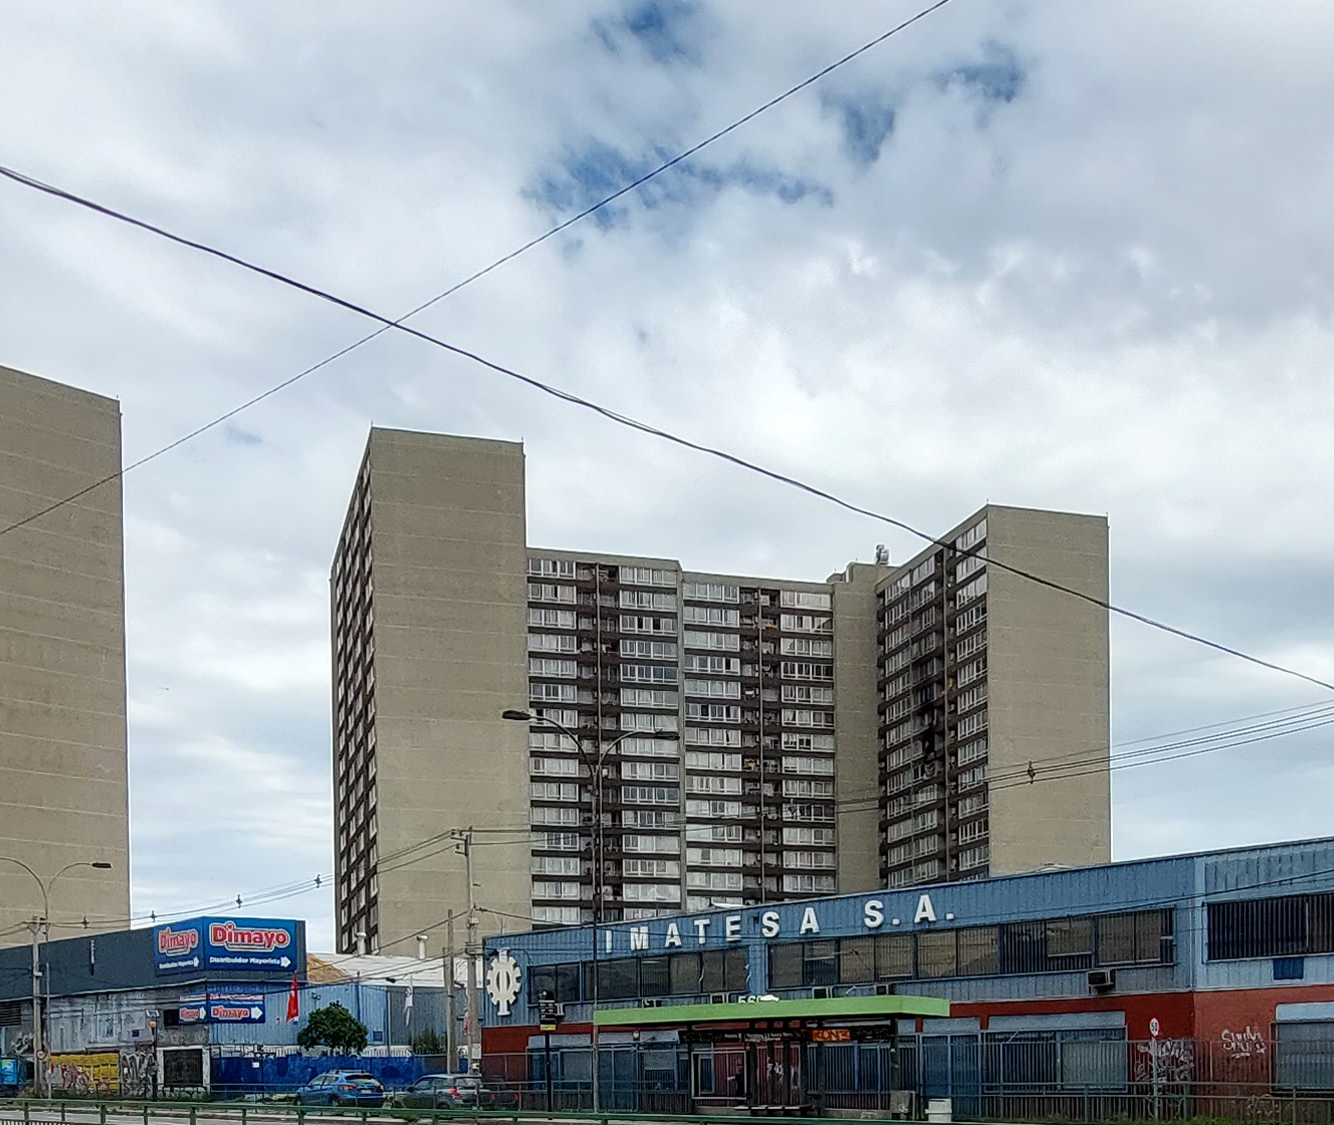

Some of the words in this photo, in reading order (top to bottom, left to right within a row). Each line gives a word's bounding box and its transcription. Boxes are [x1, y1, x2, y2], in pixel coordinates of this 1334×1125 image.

[211, 922, 288, 950] Dimayo
[605, 907, 820, 953] IMATESA
[864, 894, 955, 928] S.A.
[160, 928, 197, 949] Dimayo
